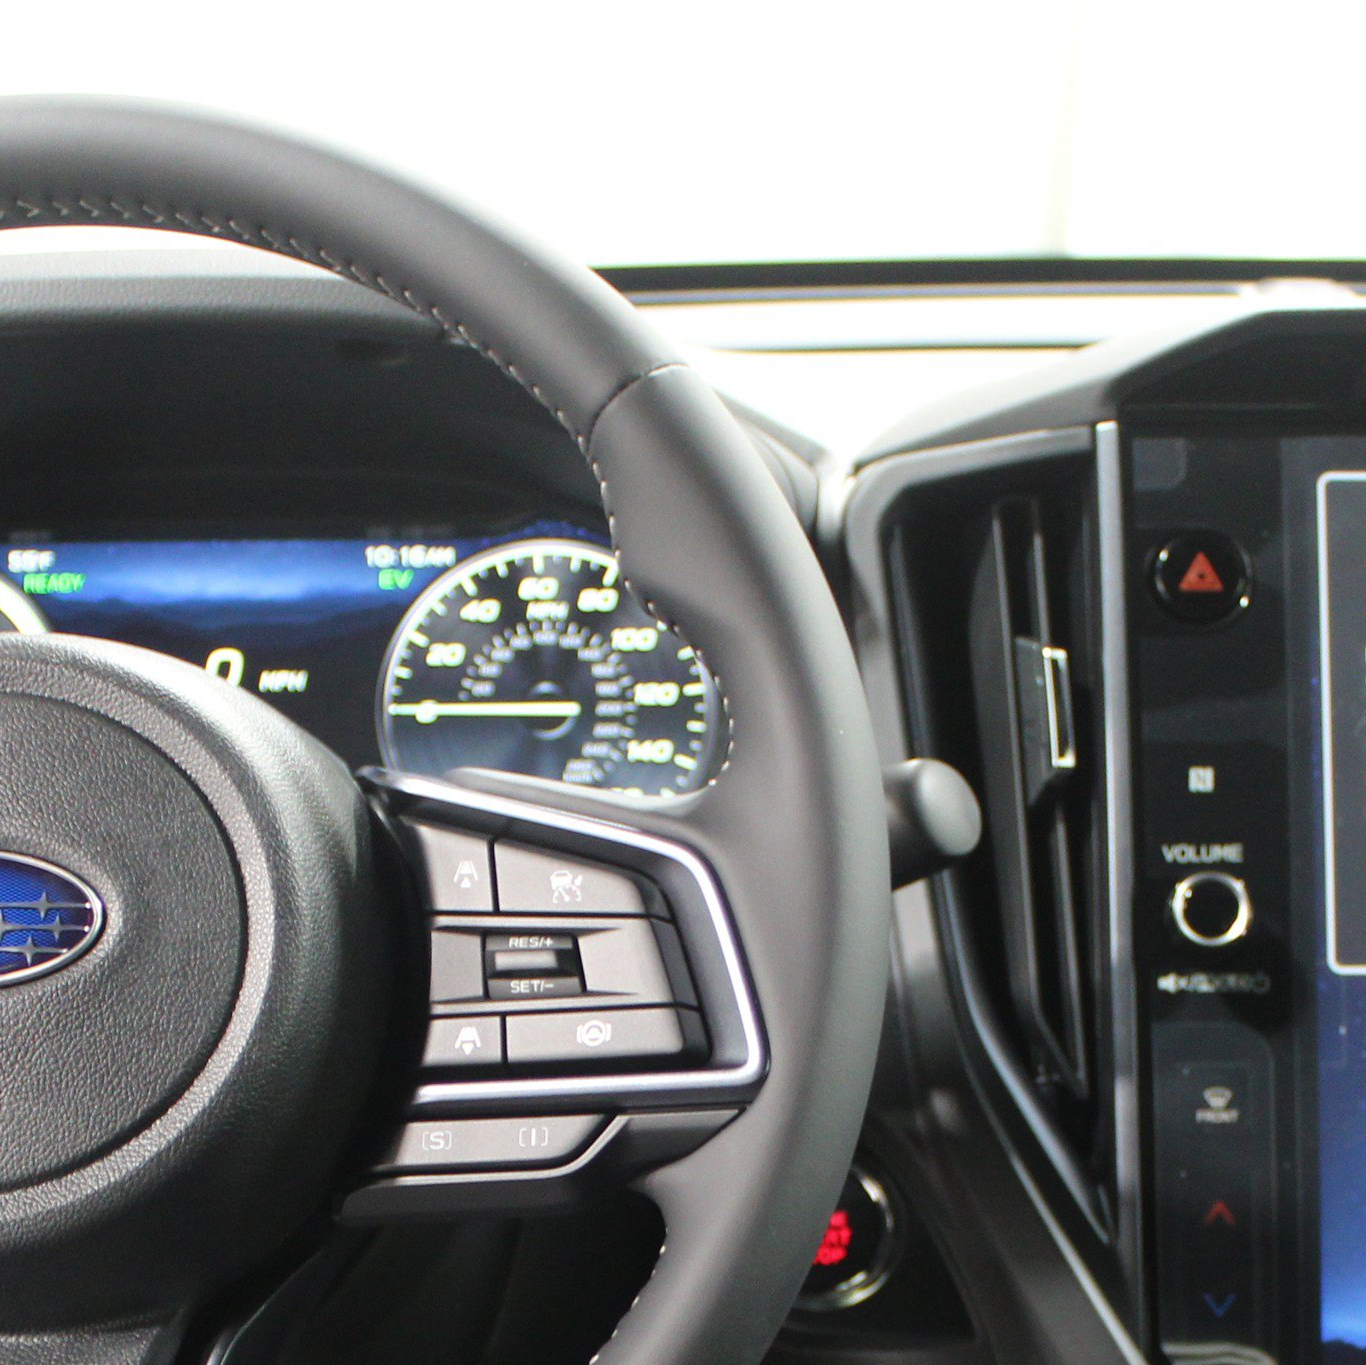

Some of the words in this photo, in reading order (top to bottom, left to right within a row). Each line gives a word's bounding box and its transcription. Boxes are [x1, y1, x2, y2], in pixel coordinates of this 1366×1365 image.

[23, 573, 86, 595] READY
[378, 568, 414, 590] EV
[518, 576, 560, 601] 60
[459, 598, 502, 623] 40
[526, 600, 569, 621] MPH
[577, 587, 620, 613] 80
[610, 626, 659, 652] 100
[425, 642, 467, 667] 20
[258, 669, 309, 693] MPH
[634, 682, 680, 707] 120
[627, 738, 675, 764] 140
[1161, 842, 1244, 864] VOLUME
[508, 935, 554, 949] RES/+
[509, 980, 554, 994] SET/-
